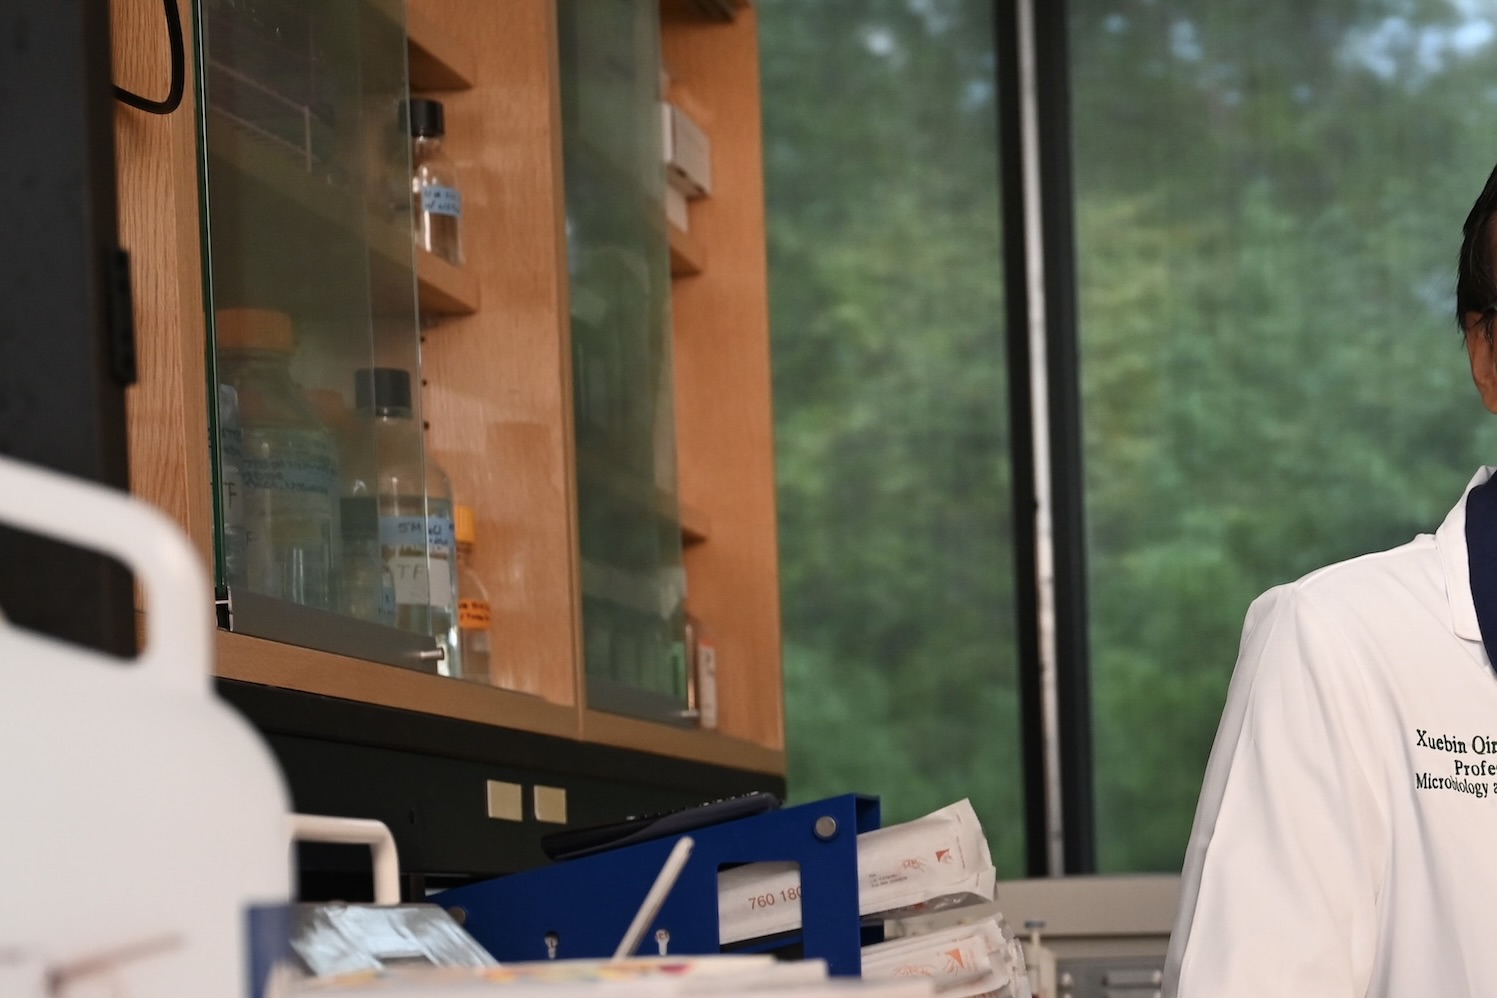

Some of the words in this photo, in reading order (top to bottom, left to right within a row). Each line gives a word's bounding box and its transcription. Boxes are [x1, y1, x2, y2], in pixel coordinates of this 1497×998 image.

[1415, 729, 1468, 754] Xuebin
[1415, 773, 1489, 798] Microbiology
[748, 893, 775, 910] 760
